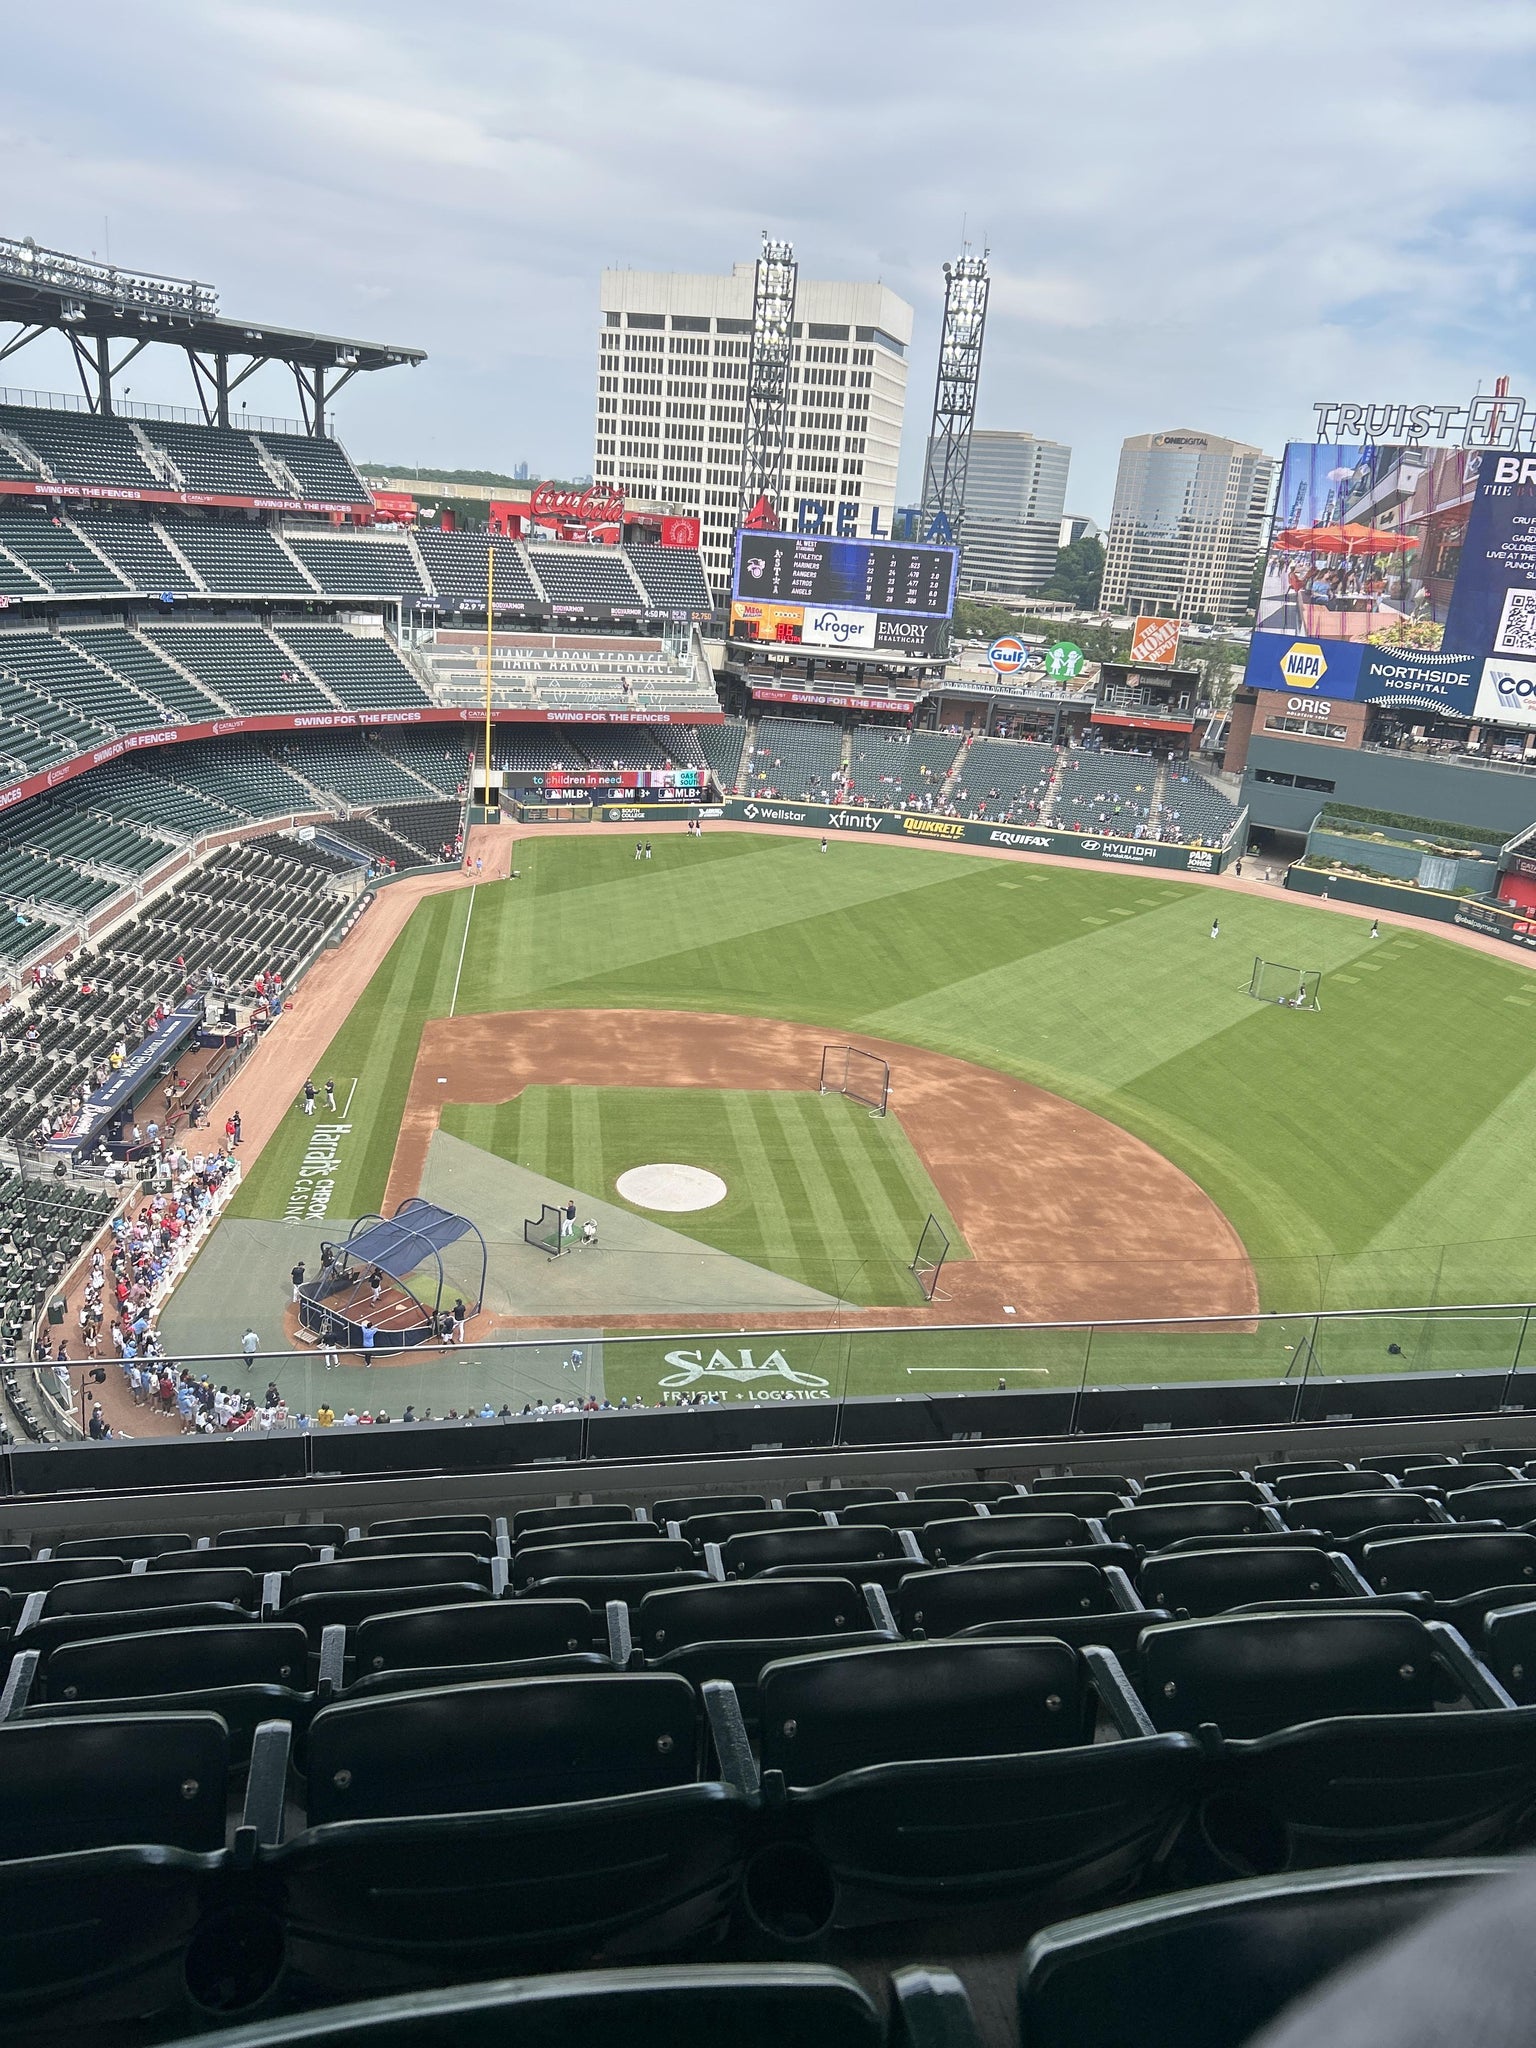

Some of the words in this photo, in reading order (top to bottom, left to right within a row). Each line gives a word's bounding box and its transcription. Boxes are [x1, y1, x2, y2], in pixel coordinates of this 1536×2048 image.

[1313, 403, 1460, 438] TRUIST
[35, 485, 62, 494] SWING
[63, 486, 80, 495] FOR
[82, 488, 100, 497] THE
[101, 489, 141, 499] FENCES
[1483, 485, 1512, 496] THE
[254, 499, 283, 509] SWING
[285, 501, 301, 510] FOR
[304, 502, 318, 511] THE
[319, 503, 352, 512] FENCES
[799, 499, 953, 541] DELTA
[1512, 516, 1531, 524] CRU
[793, 553, 823, 561] ATHLETICS
[1504, 561, 1535, 570] PUNCH
[792, 570, 817, 578] RANGERS
[791, 579, 813, 587] ASTROS
[791, 587, 812, 595] ANGELS
[814, 612, 864, 642] Kroger
[878, 621, 928, 638] EMORY
[1140, 622, 1159, 639] THE
[878, 635, 924, 644] HEALTHCARE
[1132, 619, 1180, 660] HOME
[990, 649, 1024, 662] Gulf
[1148, 636, 1178, 661] DEPOT
[1287, 656, 1319, 677] NAPA
[1370, 663, 1471, 687] NORTHSIDE
[1385, 679, 1448, 695] HOSPITAL
[1498, 677, 1536, 697] CO
[792, 694, 826, 704] SWING
[826, 696, 847, 705] FOR
[850, 699, 869, 707] THE
[870, 700, 910, 711] FENCES
[1287, 697, 1331, 715] ORIS
[294, 717, 332, 726] SWING
[334, 716, 355, 725] FOR
[359, 715, 379, 723] THE
[380, 713, 420, 722] FENCES
[547, 712, 583, 721] SWING
[585, 713, 606, 721] FOR
[630, 714, 670, 722] FENCES
[93, 748, 113, 763] SWING
[113, 744, 124, 755] FOR
[124, 739, 138, 750] THE
[139, 731, 178, 745] FENCES
[533, 776, 543, 784] to
[546, 775, 586, 784] children
[588, 775, 596, 784] in
[599, 775, 624, 784] need.
[562, 789, 589, 798] MLB+
[625, 789, 650, 798] MB+
[675, 788, 700, 797] MLB+
[761, 808, 806, 821] Wellstar
[828, 810, 883, 831] xfinity
[903, 817, 964, 835] QUIKRETE
[990, 831, 1050, 847] EQUIFAX
[1103, 842, 1157, 857] HYUNDAI
[1188, 851, 1212, 861] PAPA
[1187, 859, 1212, 867] JOHNS
[658, 1349, 829, 1387] SAIA
